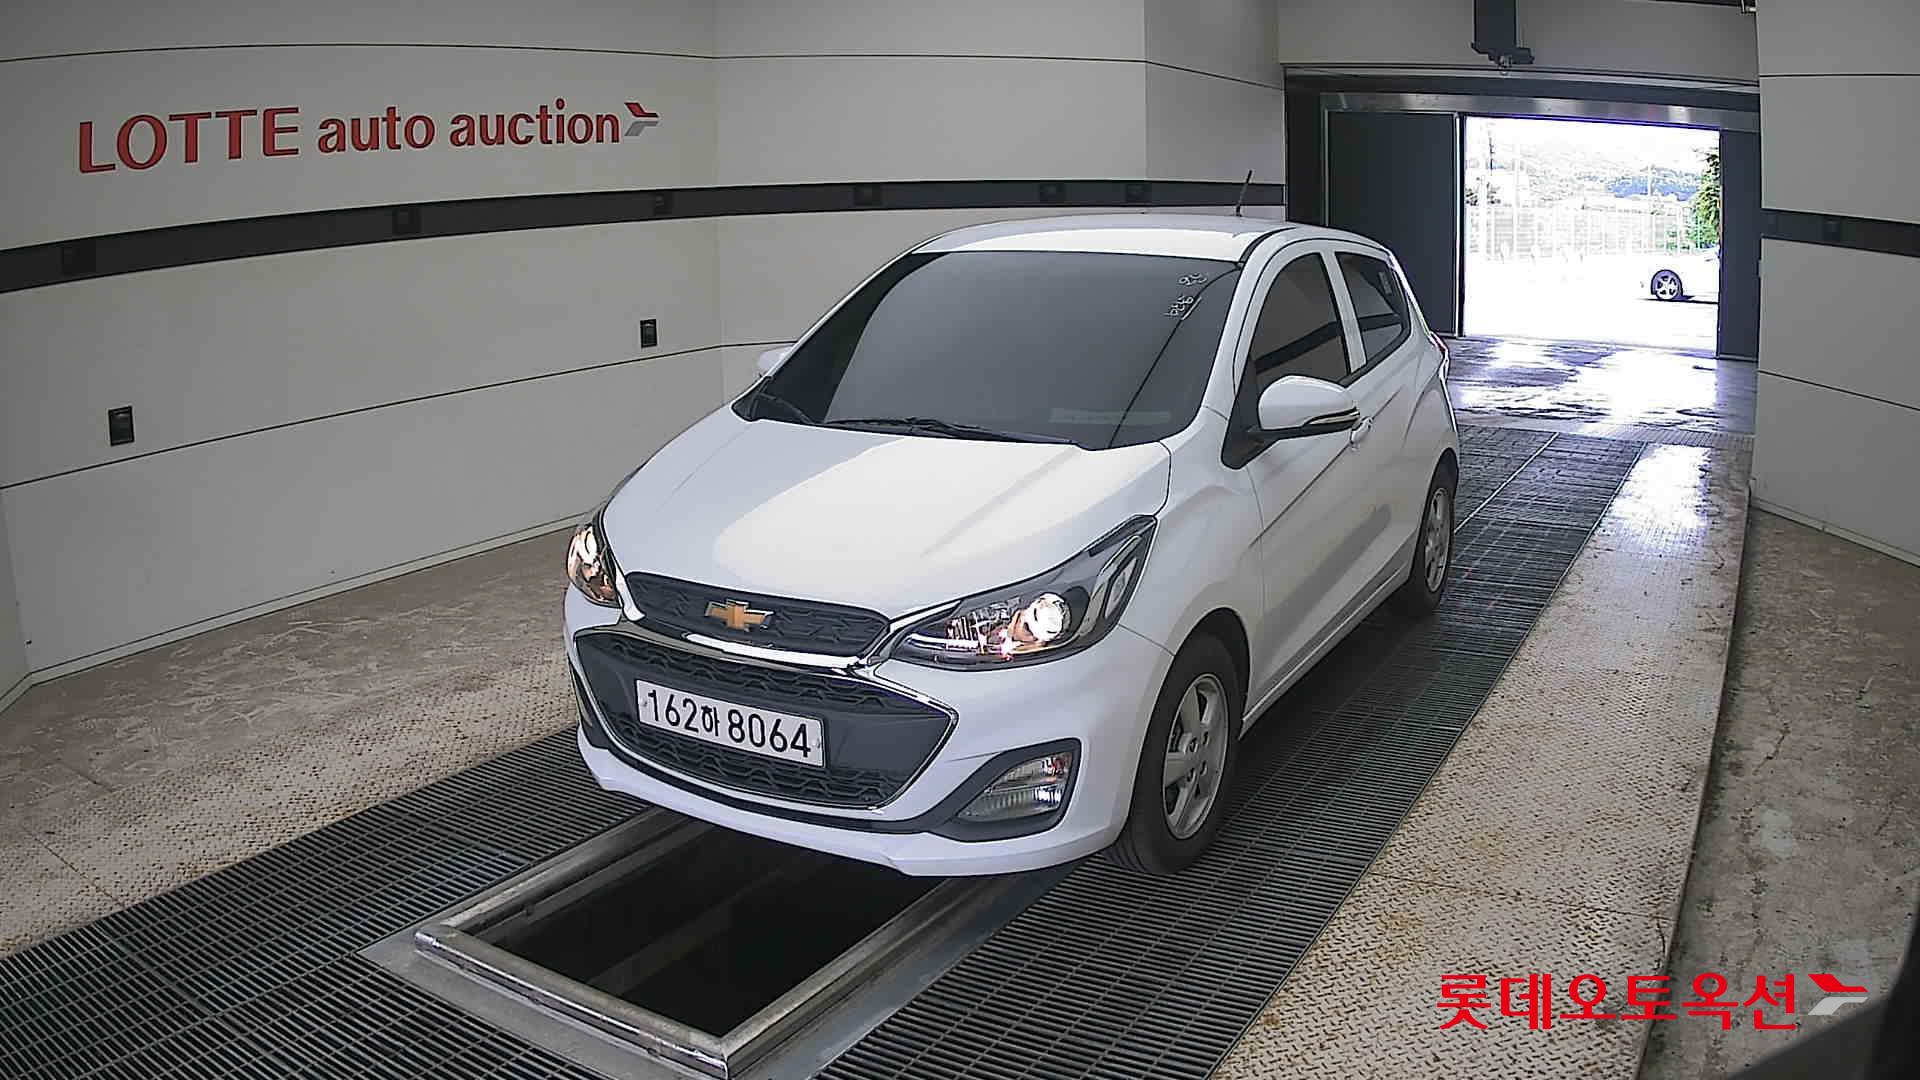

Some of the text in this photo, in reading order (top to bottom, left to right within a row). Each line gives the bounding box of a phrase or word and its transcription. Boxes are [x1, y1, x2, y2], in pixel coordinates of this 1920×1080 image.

[79, 97, 620, 174] LOTTE auto auction
[647, 689, 812, 758] 162하 8064
